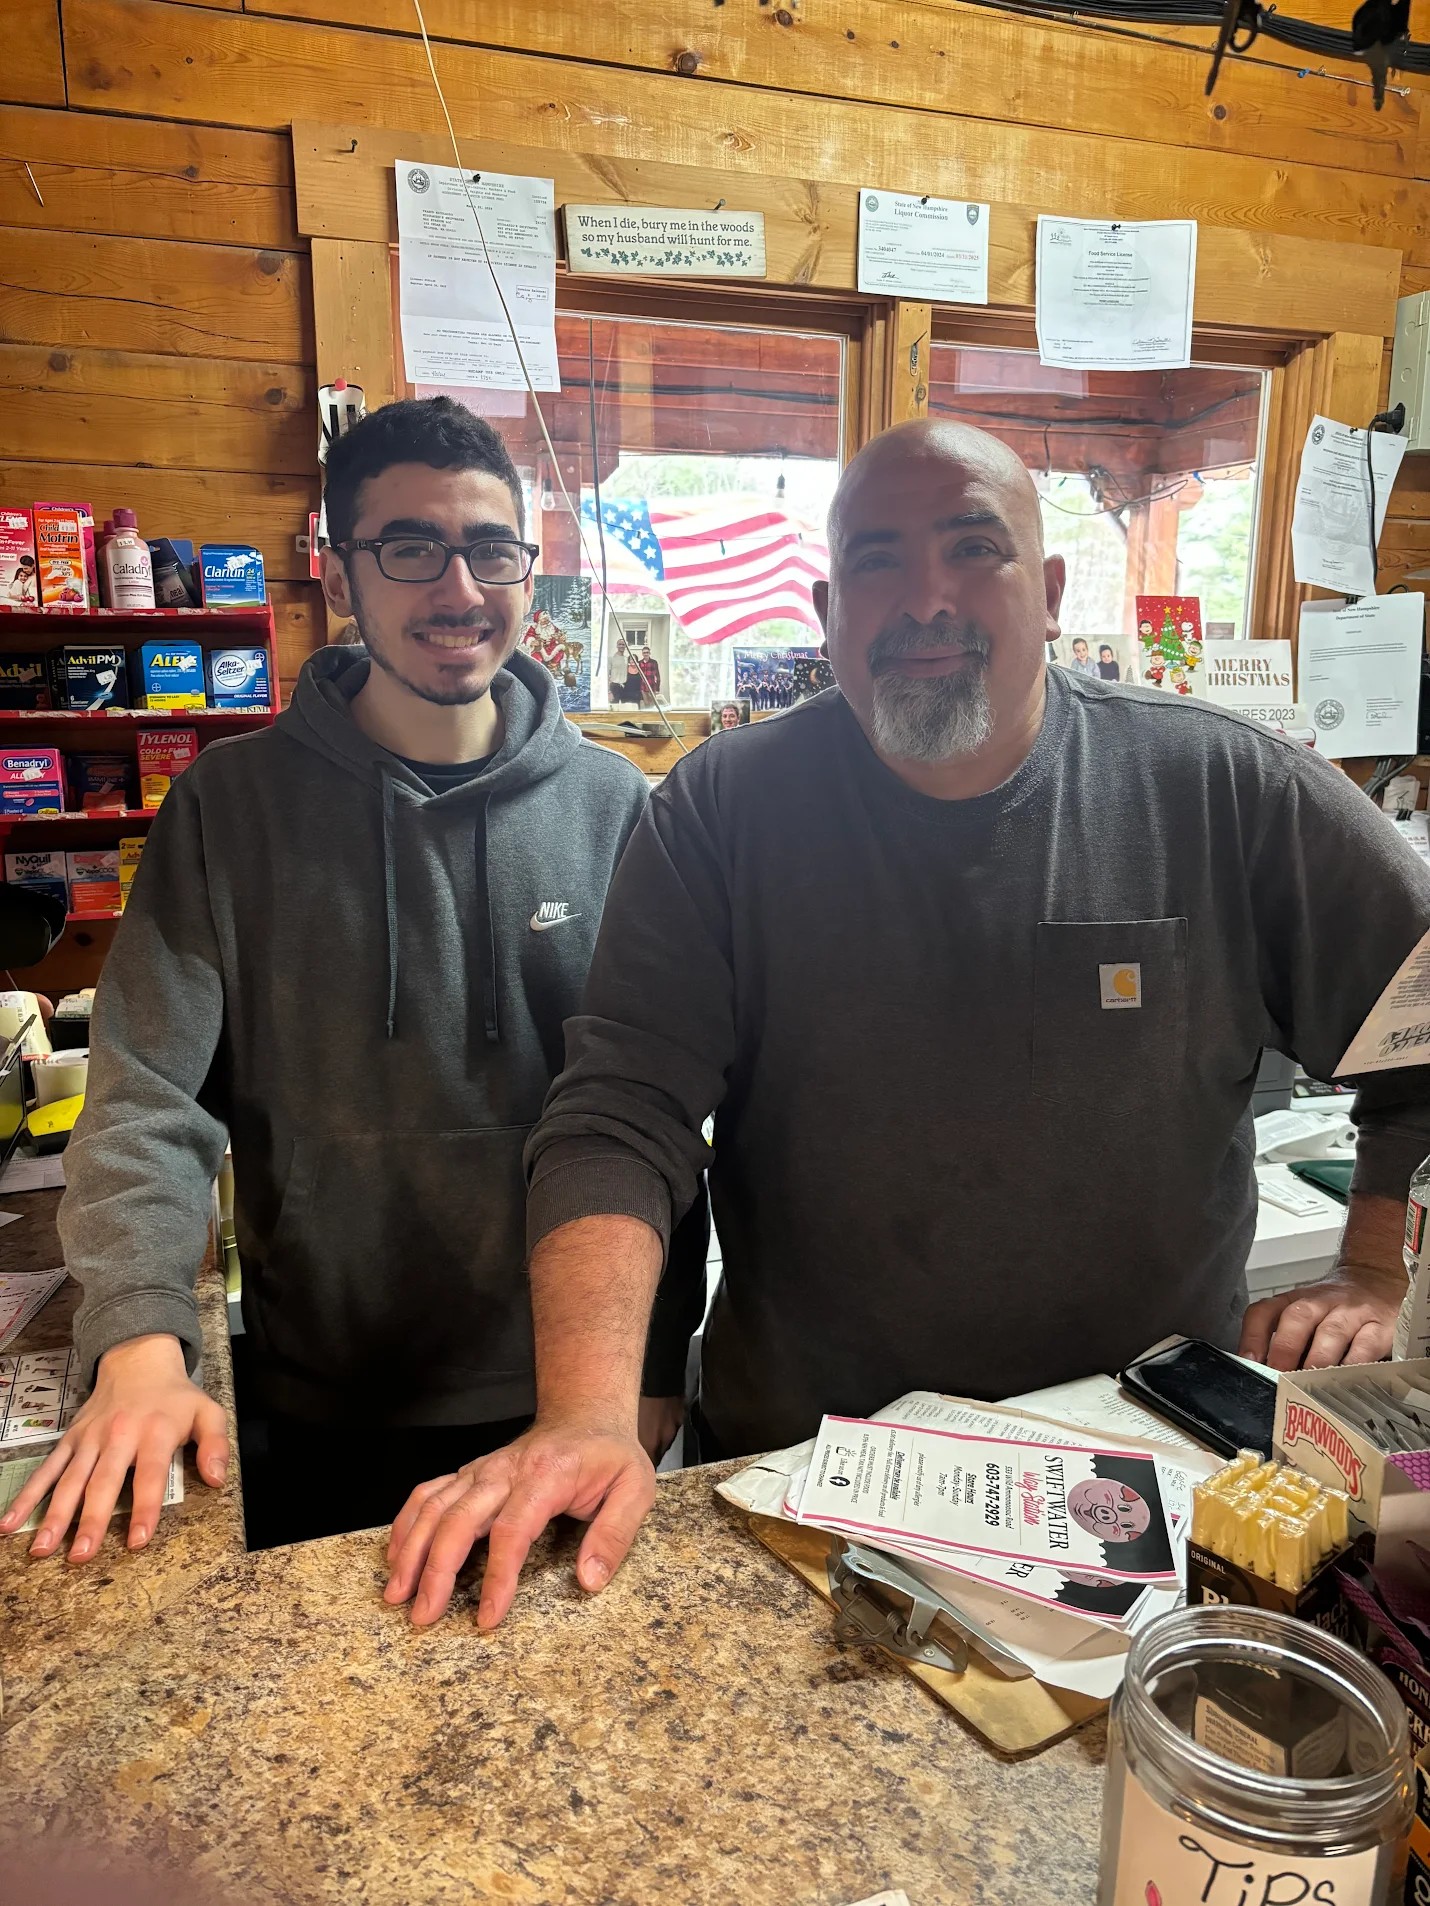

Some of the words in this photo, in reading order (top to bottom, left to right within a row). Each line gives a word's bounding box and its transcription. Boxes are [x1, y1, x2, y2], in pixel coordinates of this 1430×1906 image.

[894, 208, 914, 218] Liquor
[914, 211, 948, 220] Commission
[578, 215, 611, 228] When
[613, 217, 618, 229] I
[620, 217, 640, 230] die,
[641, 219, 667, 232] bury
[670, 221, 687, 231] me
[688, 220, 699, 231] in
[701, 221, 718, 231] the
[720, 222, 755, 233] woods
[582, 233, 595, 242] so
[597, 234, 614, 245] my
[616, 233, 665, 244] husband
[667, 233, 688, 245] will
[689, 234, 715, 246] hunt
[717, 235, 732, 247] for
[733, 237, 752, 247] me.
[40, 533, 79, 543] Motrin
[112, 563, 151, 577] Caladryl
[204, 566, 245, 578] Claritin
[68, 656, 97, 665] Advil
[97, 655, 116, 664] PM
[744, 650, 768, 662] Merry
[771, 651, 808, 660] Christmas
[216, 667, 245, 677] Seltzer
[219, 661, 240, 669] Alka-
[1214, 659, 1272, 671] MERRY
[1206, 673, 1290, 686] HRISTMAS
[1269, 709, 1295, 720] 2023
[139, 733, 193, 745] TYLENOL
[7, 759, 49, 769] Benadryl
[16, 854, 51, 865] NyQuil
[539, 902, 569, 918] NIKE
[1286, 1404, 1361, 1496] BACKWOODS
[894, 1451, 905, 1469] Delivery
[916, 1452, 925, 1465] please
[914, 1464, 924, 1476] notify
[935, 1472, 947, 1496] 7am-7pm
[949, 1464, 962, 1507] Monday-Sunday
[967, 1473, 976, 1488] Store
[1014, 1469, 1043, 1493] Way
[891, 1483, 901, 1500] available
[911, 1490, 922, 1506] allergies
[966, 1487, 976, 1504] Hours
[984, 1462, 999, 1526] 603-747-2929
[1020, 1491, 1046, 1527] Station
[1044, 1454, 1069, 1551] SWIFTWATER
[1005, 1516, 1014, 1529] Road
[1190, 1550, 1226, 1575] ORIGINAL
[1399, 1671, 1430, 1709] HON
[1232, 1723, 1257, 1745] GENERAL
